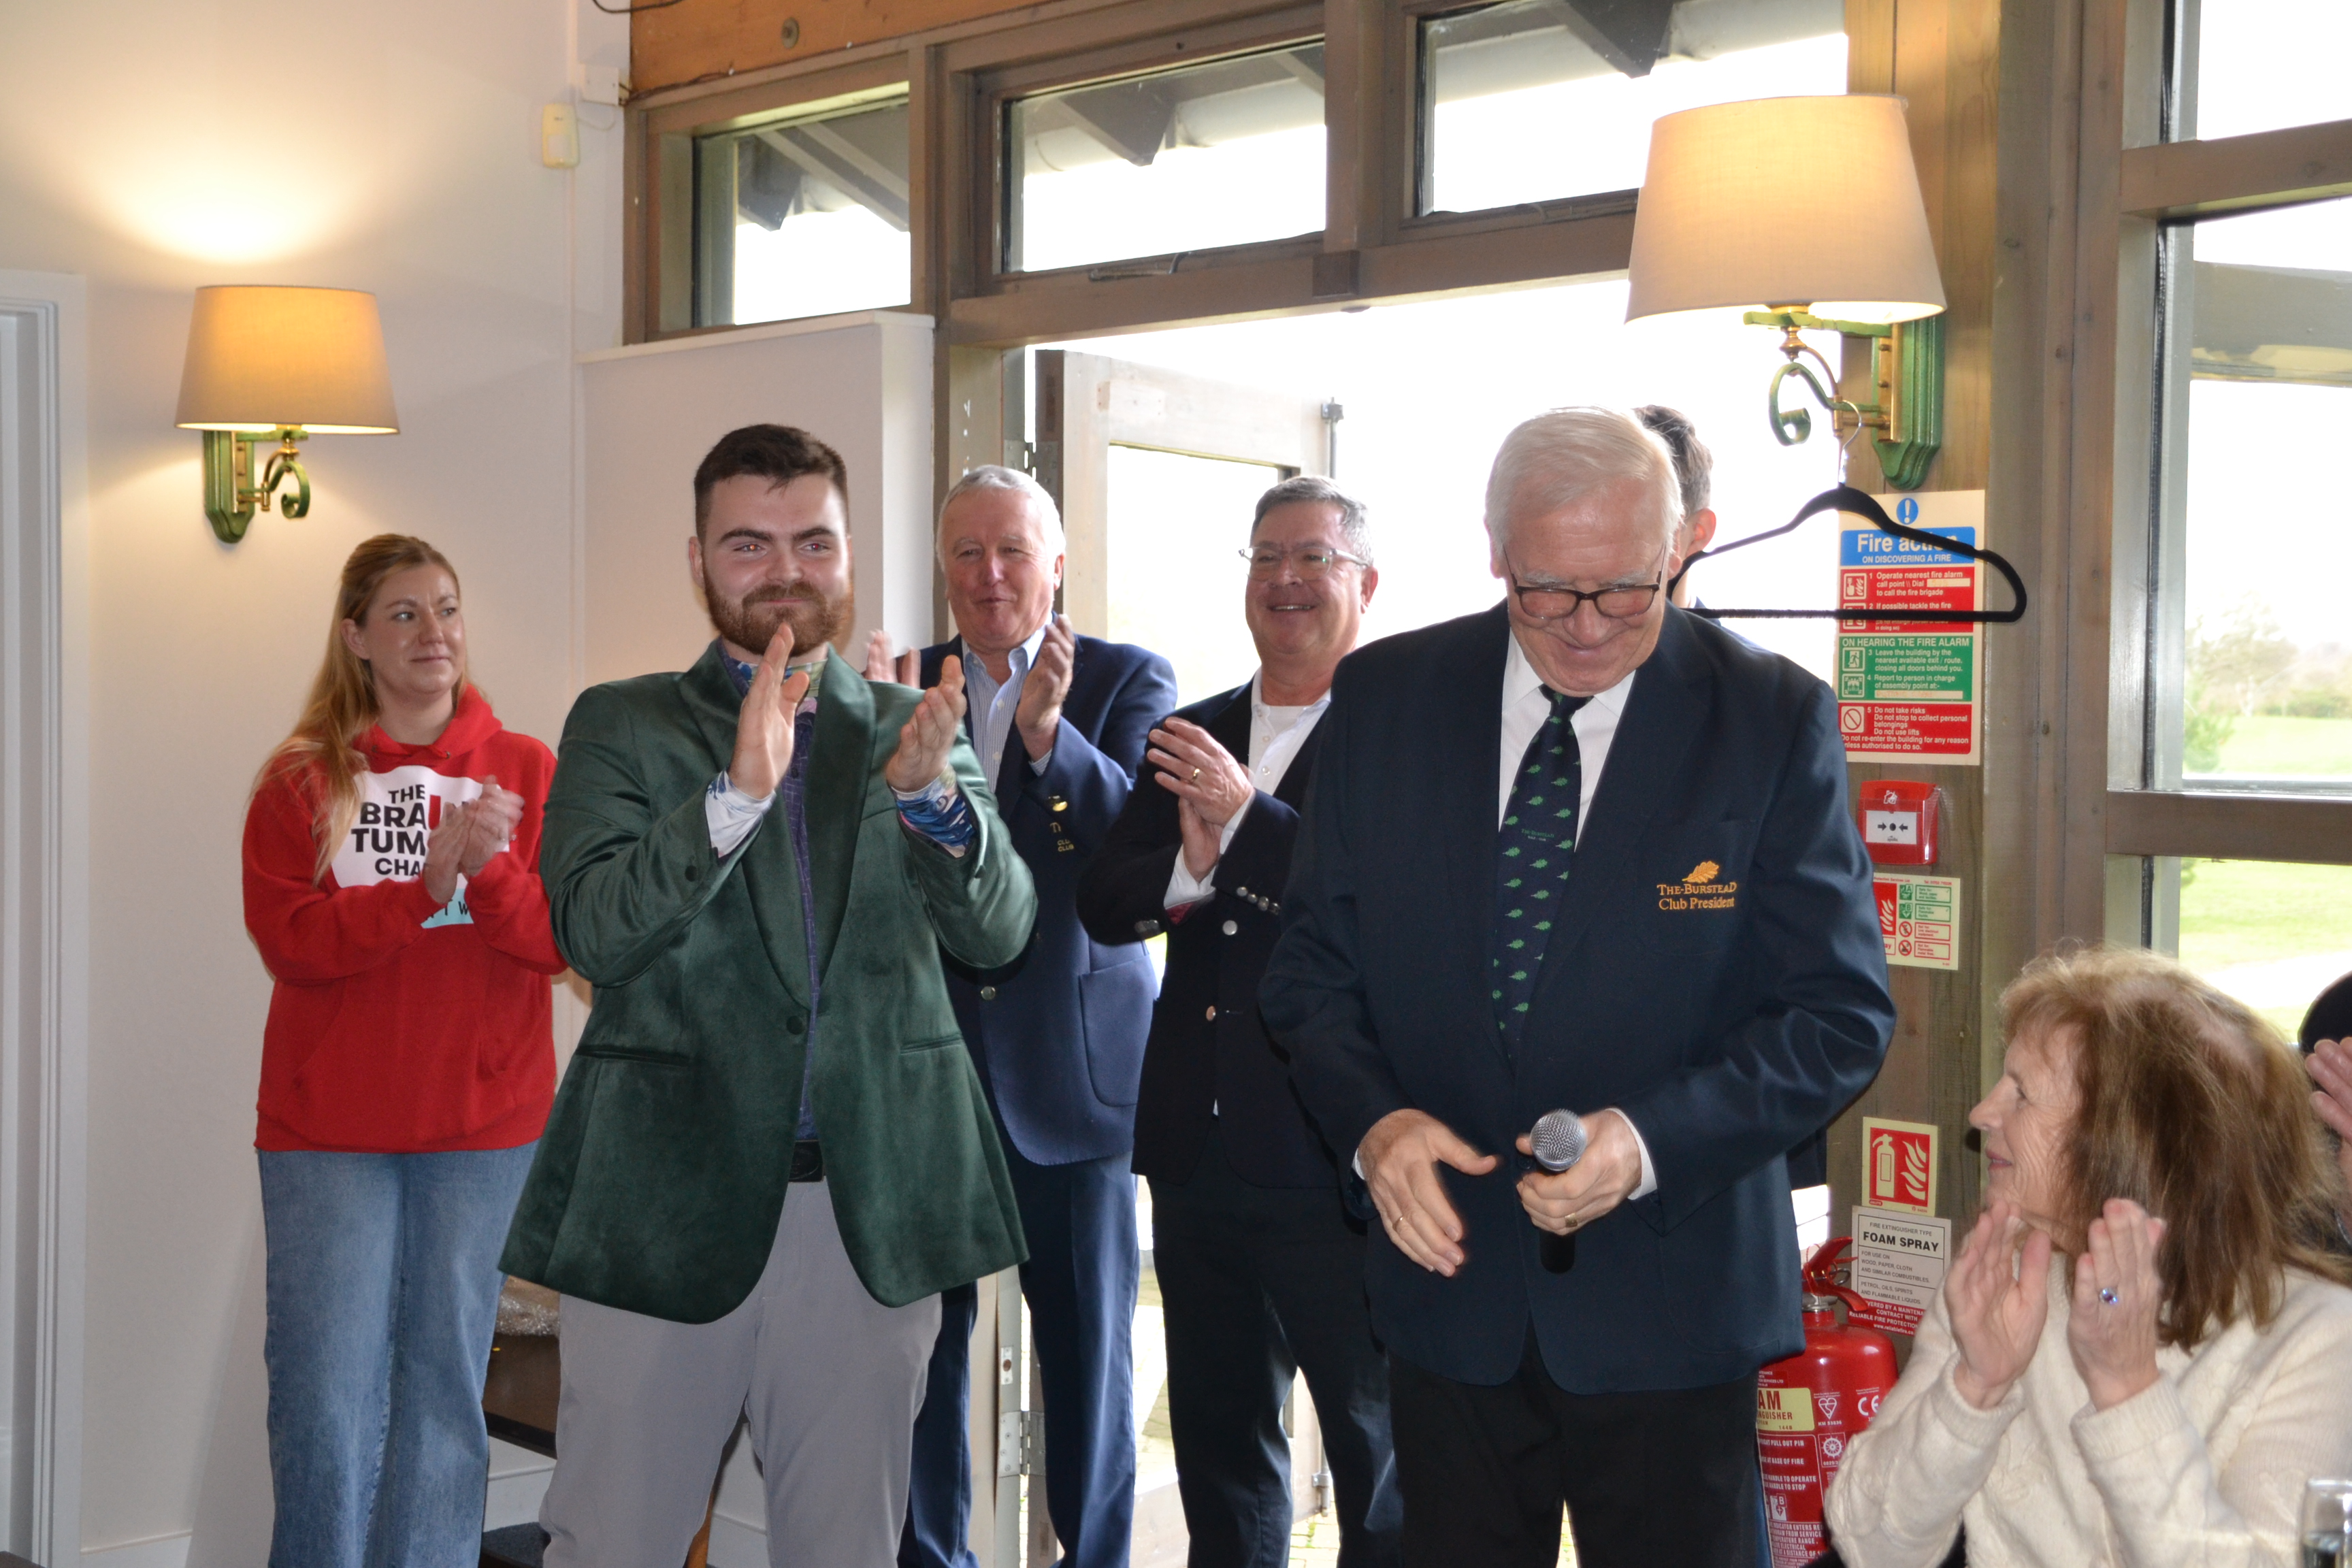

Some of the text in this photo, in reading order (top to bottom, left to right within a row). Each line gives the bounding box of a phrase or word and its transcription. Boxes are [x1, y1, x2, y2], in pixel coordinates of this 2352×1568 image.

[1858, 534, 1893, 553] Fire
[1862, 555, 1873, 564] ON
[1876, 555, 1925, 564] DISCOVERING
[1877, 572, 1903, 580] Operate
[1889, 581, 1904, 589] point
[1919, 589, 1944, 597] brigade
[1842, 638, 1970, 647] ON HEARING THE FIRE ALARM
[1882, 682, 1911, 690] assembly
[1898, 736, 1923, 744] building
[388, 784, 425, 804] THE
[351, 828, 426, 856] TUM
[1659, 896, 1734, 911] Club President
[1882, 1224, 1918, 1235] EXTINGUISHER
[1863, 1231, 1939, 1252] FOAM SPRAY
[1892, 1273, 1929, 1284] COMBUSTIBLES.
[1861, 1281, 1880, 1290] PETROL,
[1872, 1292, 1900, 1301] FLAMMABLE
[1867, 1301, 1884, 1309] VERED
[1899, 1306, 1923, 1316] MAINTENA
[1849, 1311, 1873, 1320] RELIABLE
[1876, 1309, 1904, 1319] CONTRACT
[1874, 1323, 1915, 1335] www.reliablefire.co.
[1758, 1390, 1782, 1410] AM
[1757, 1411, 1793, 1420] NGUISHER
[1779, 1497, 1784, 1505] B
